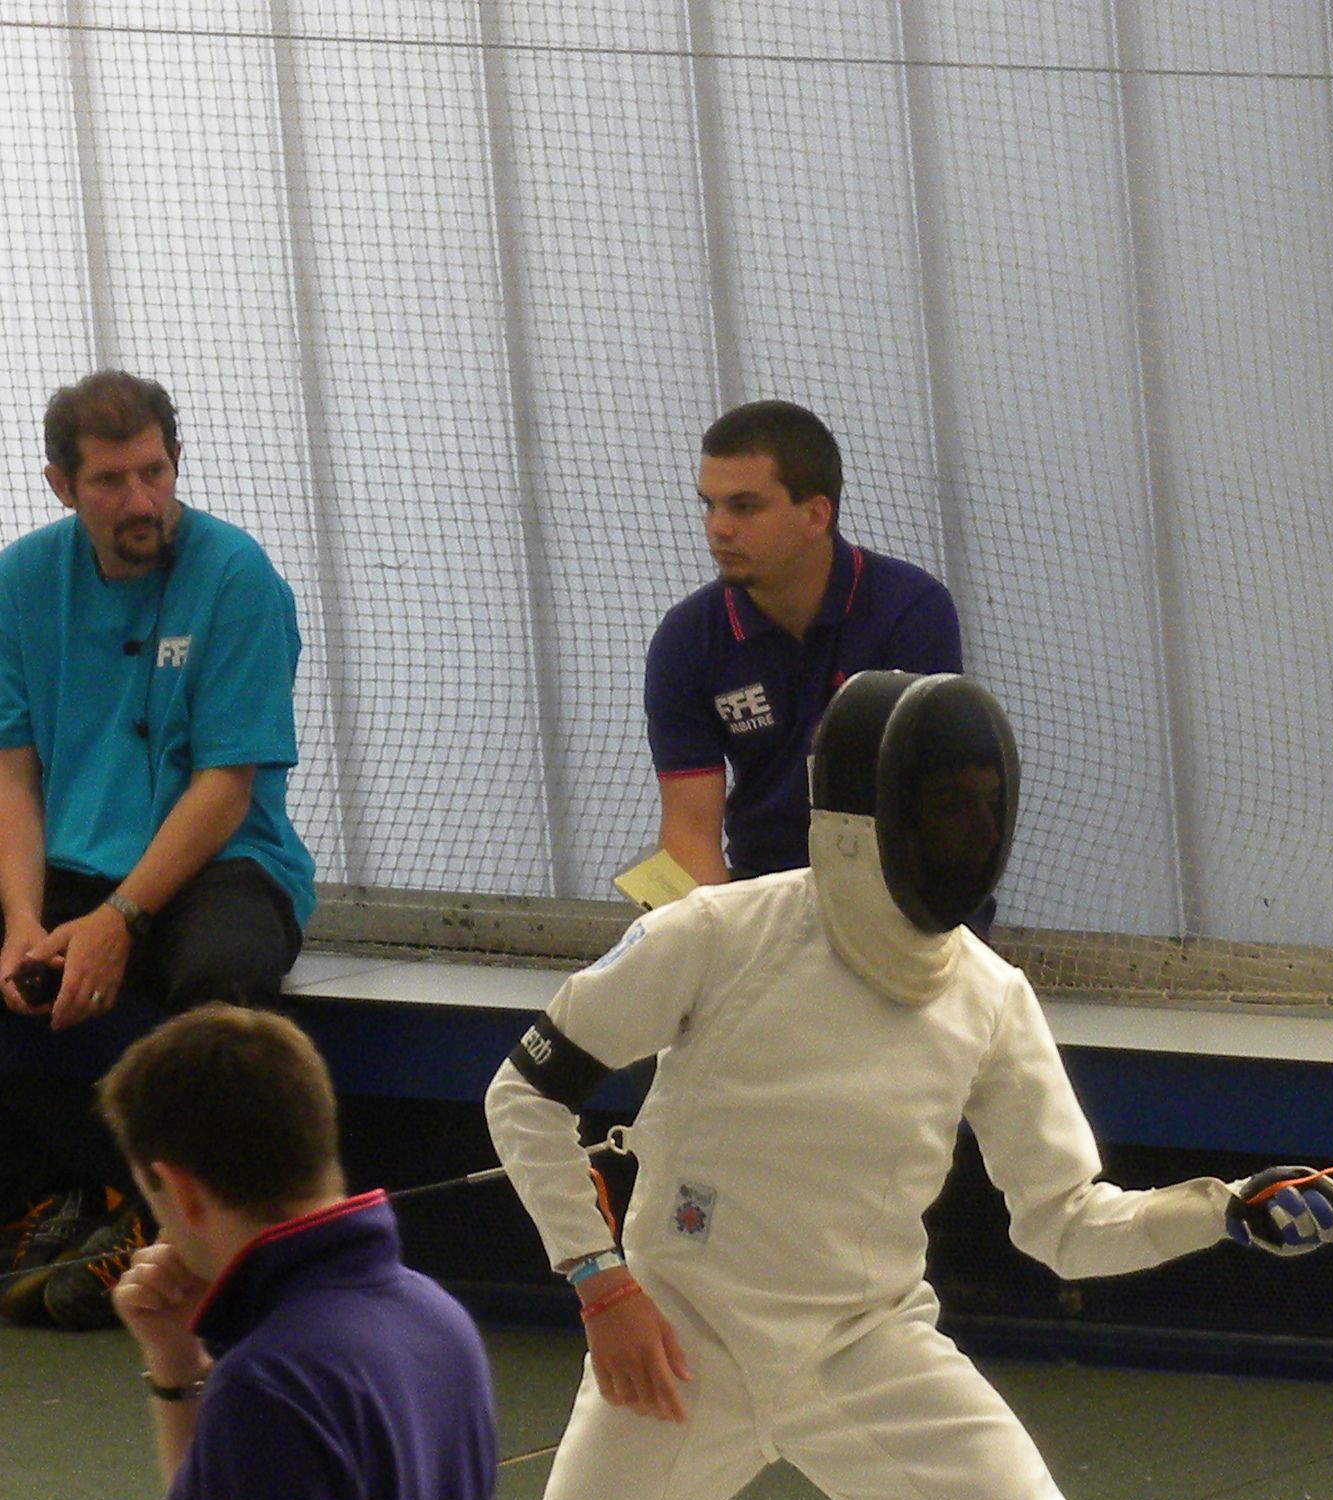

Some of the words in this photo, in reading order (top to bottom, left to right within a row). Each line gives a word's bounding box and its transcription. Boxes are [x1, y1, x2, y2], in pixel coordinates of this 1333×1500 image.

[157, 634, 191, 668] FF
[714, 682, 771, 721] FFE
[728, 712, 775, 734] RBITRE
